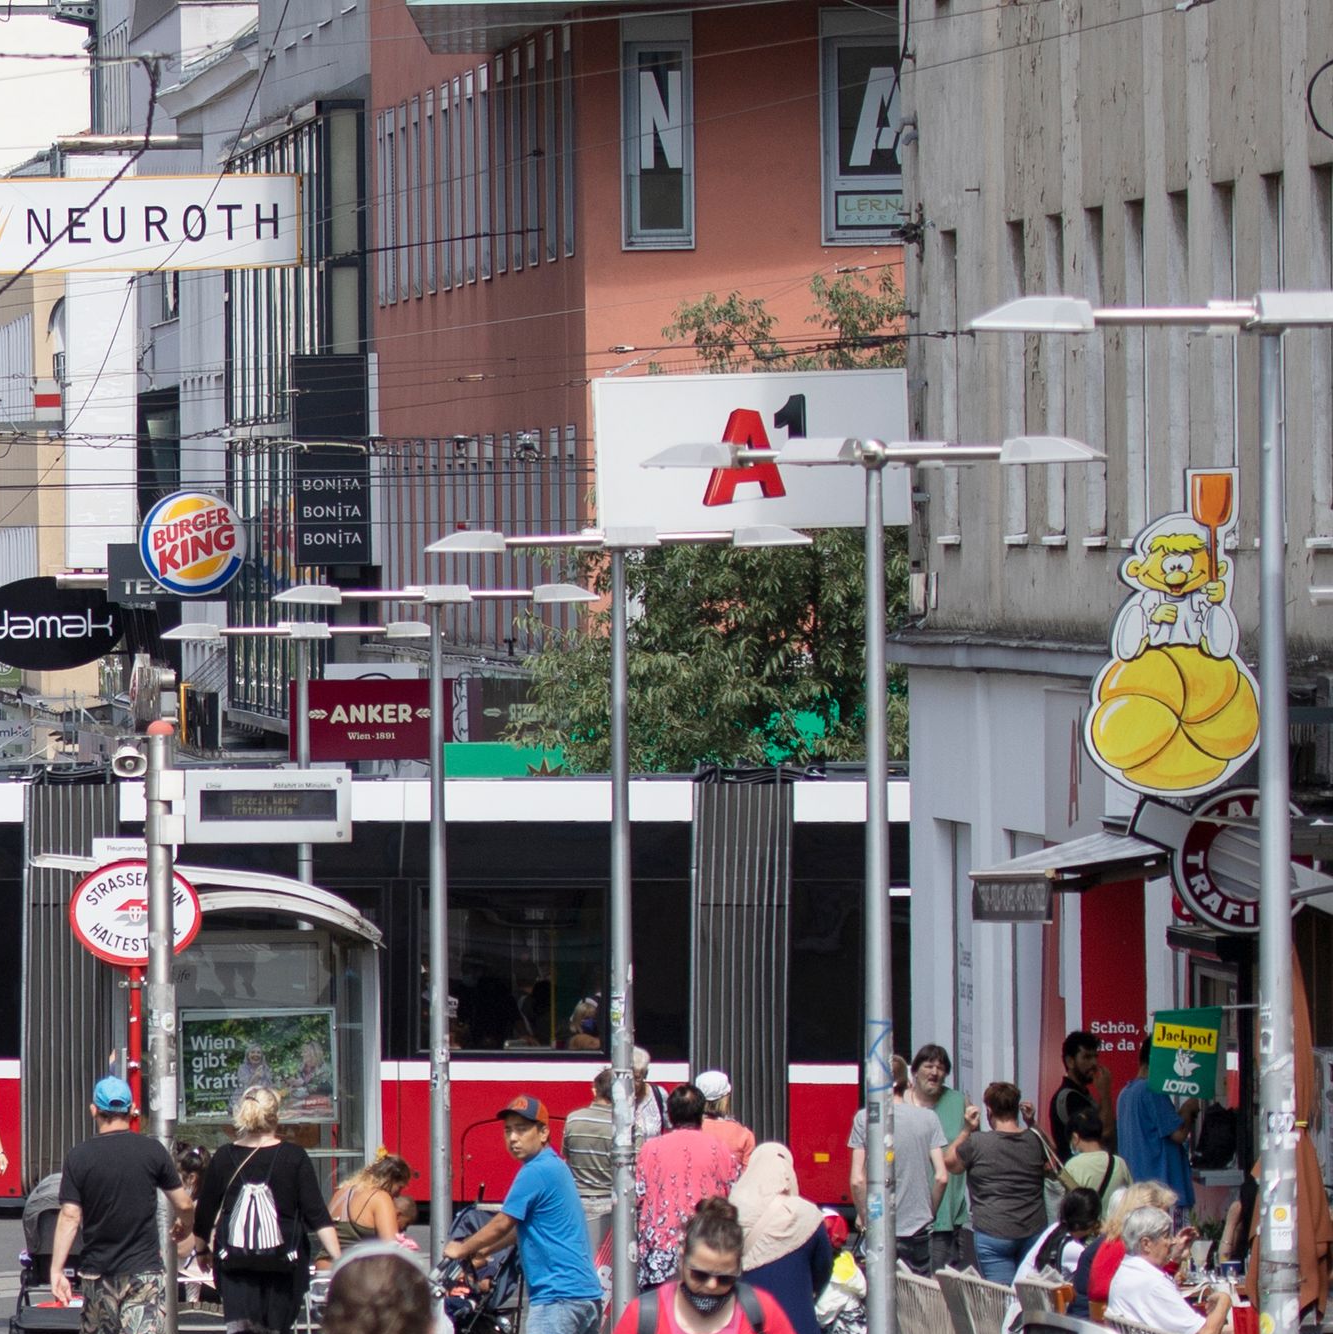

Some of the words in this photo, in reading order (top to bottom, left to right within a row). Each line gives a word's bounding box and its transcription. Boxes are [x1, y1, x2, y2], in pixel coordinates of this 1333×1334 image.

[27, 202, 280, 245] NEUROTH
[844, 213, 902, 223] EXPRE
[152, 506, 230, 551] BURGER
[158, 525, 236, 578] KING
[330, 704, 413, 724] ANKER
[106, 845, 148, 853] Reumannpl
[1186, 850, 1260, 924] TRAFI
[1090, 1021, 1140, 1036] Schön,
[1157, 1024, 1213, 1049] Jackpot
[190, 1034, 236, 1051] Wien
[1117, 1038, 1136, 1052] da
[191, 1052, 228, 1073] gibt
[192, 1073, 244, 1090] Kraft.
[1162, 1079, 1200, 1095] LOTTO
